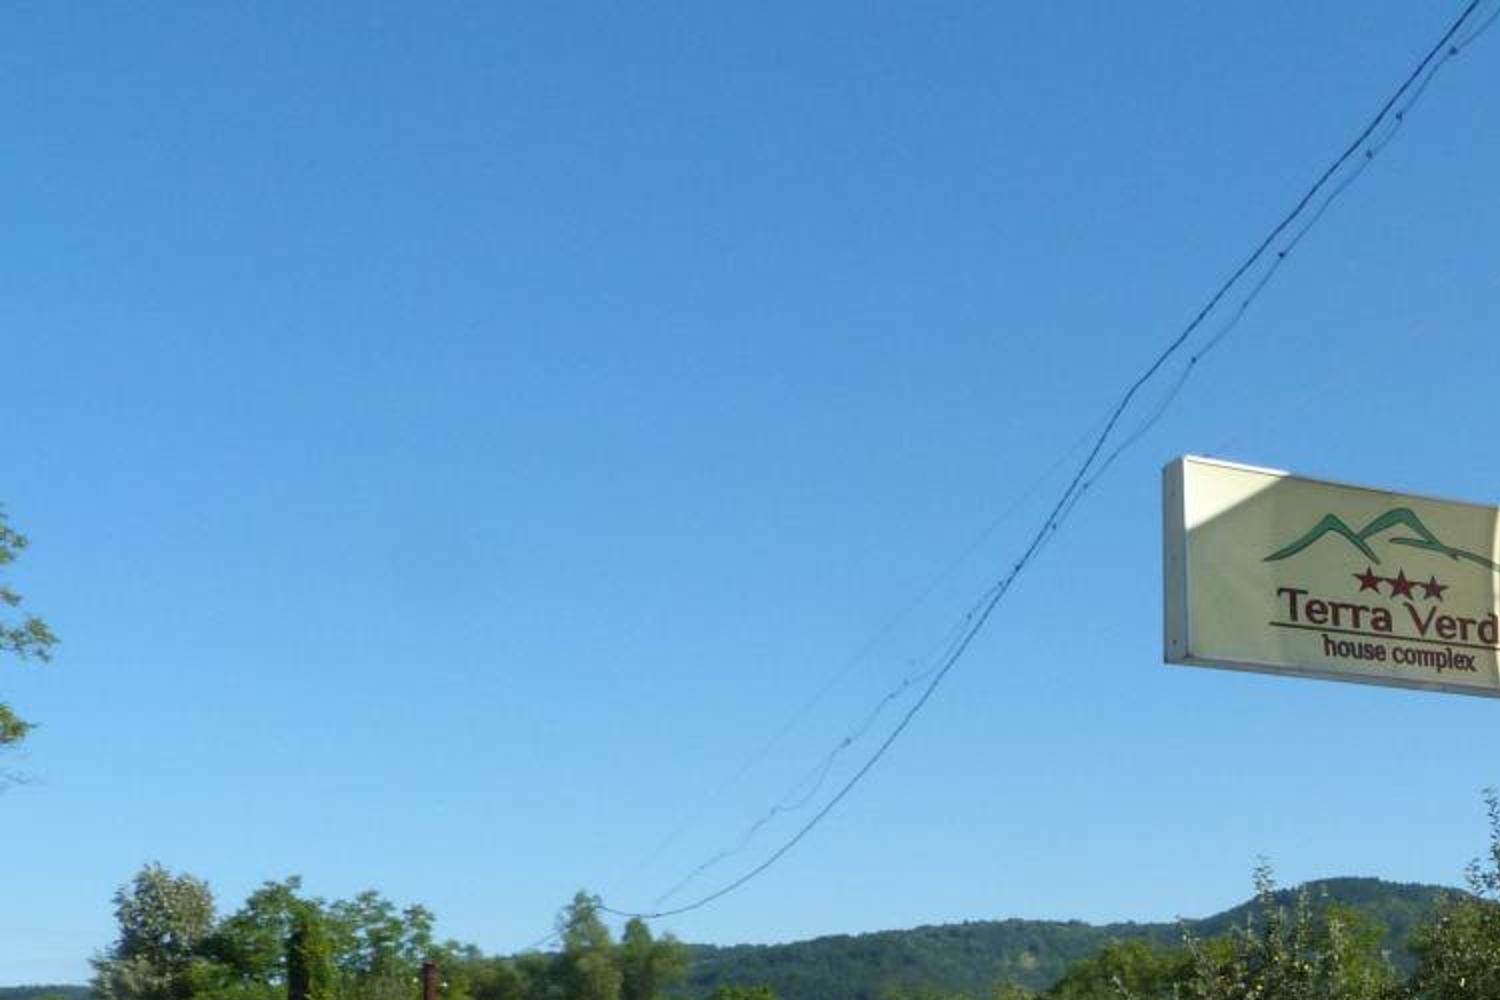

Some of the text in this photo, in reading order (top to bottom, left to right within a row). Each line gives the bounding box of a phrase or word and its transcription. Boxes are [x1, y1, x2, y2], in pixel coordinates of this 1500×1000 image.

[1277, 586, 1393, 633] Terra
[1320, 633, 1478, 673] house complex
